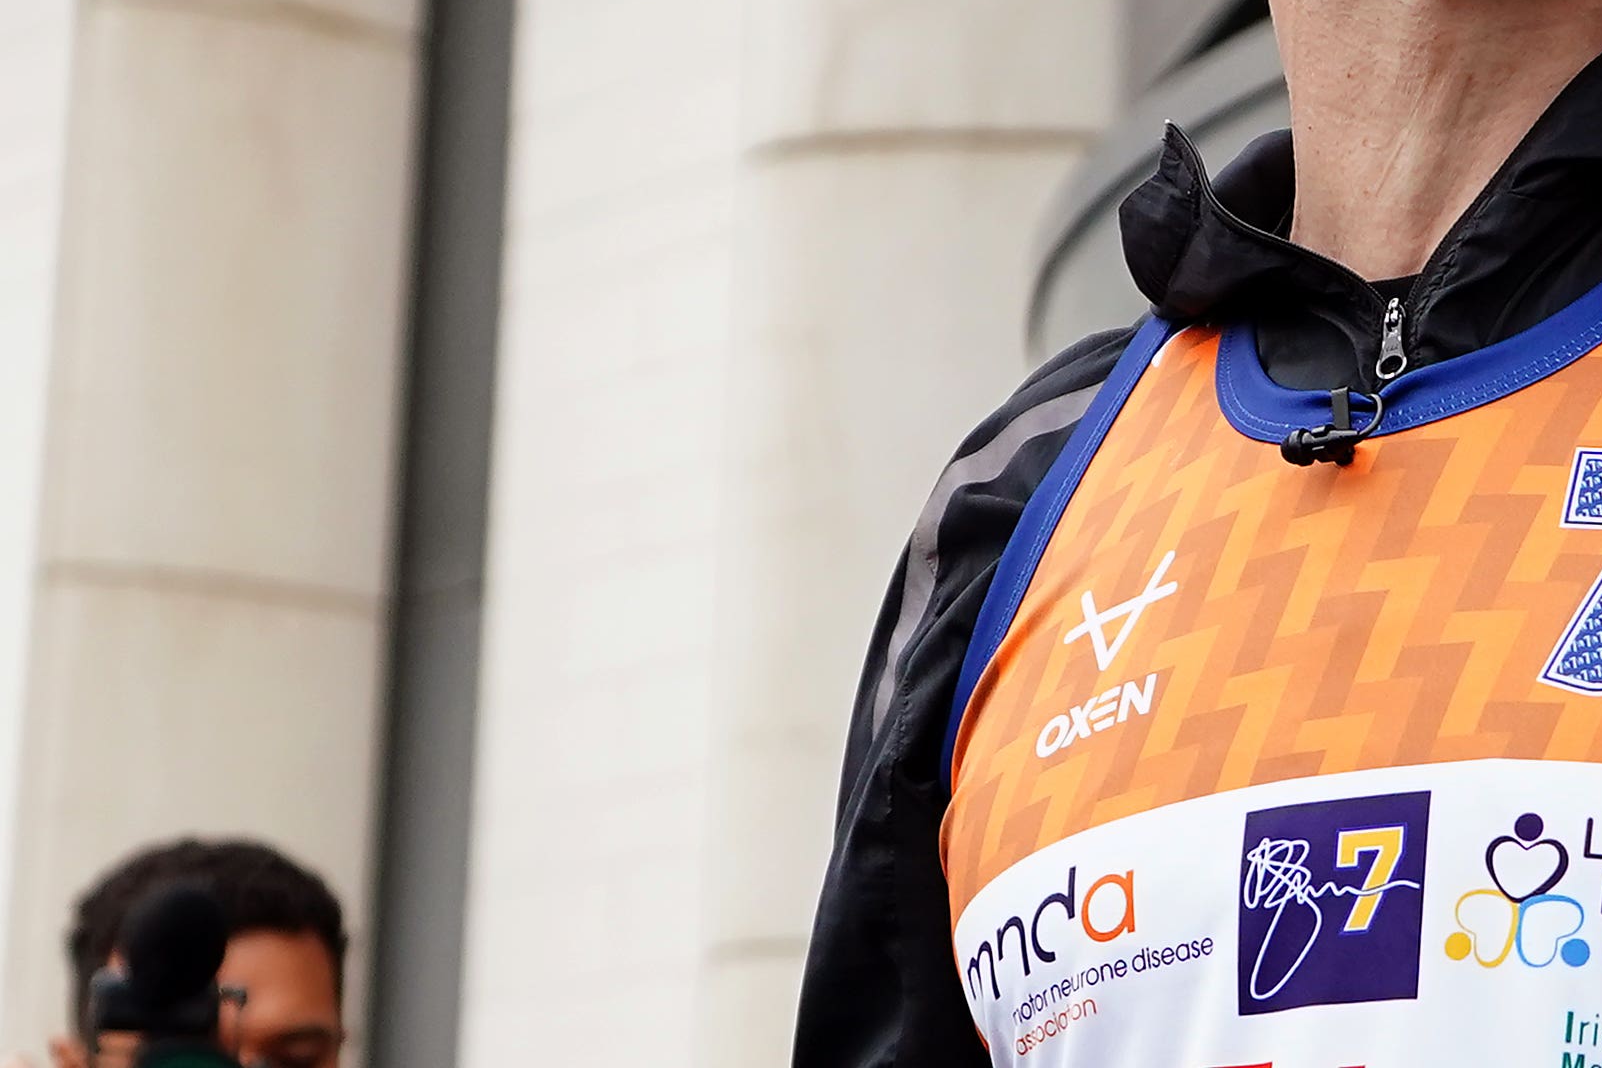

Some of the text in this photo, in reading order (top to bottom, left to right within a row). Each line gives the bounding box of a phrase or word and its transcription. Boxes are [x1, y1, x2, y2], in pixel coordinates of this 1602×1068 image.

[1035, 672, 1158, 759] OXEN
[1335, 823, 1407, 934] 7
[967, 866, 1136, 1001] mnda
[1050, 958, 1127, 1003] neurone
[1132, 937, 1214, 973] disease
[1015, 998, 1097, 1055] associaon
